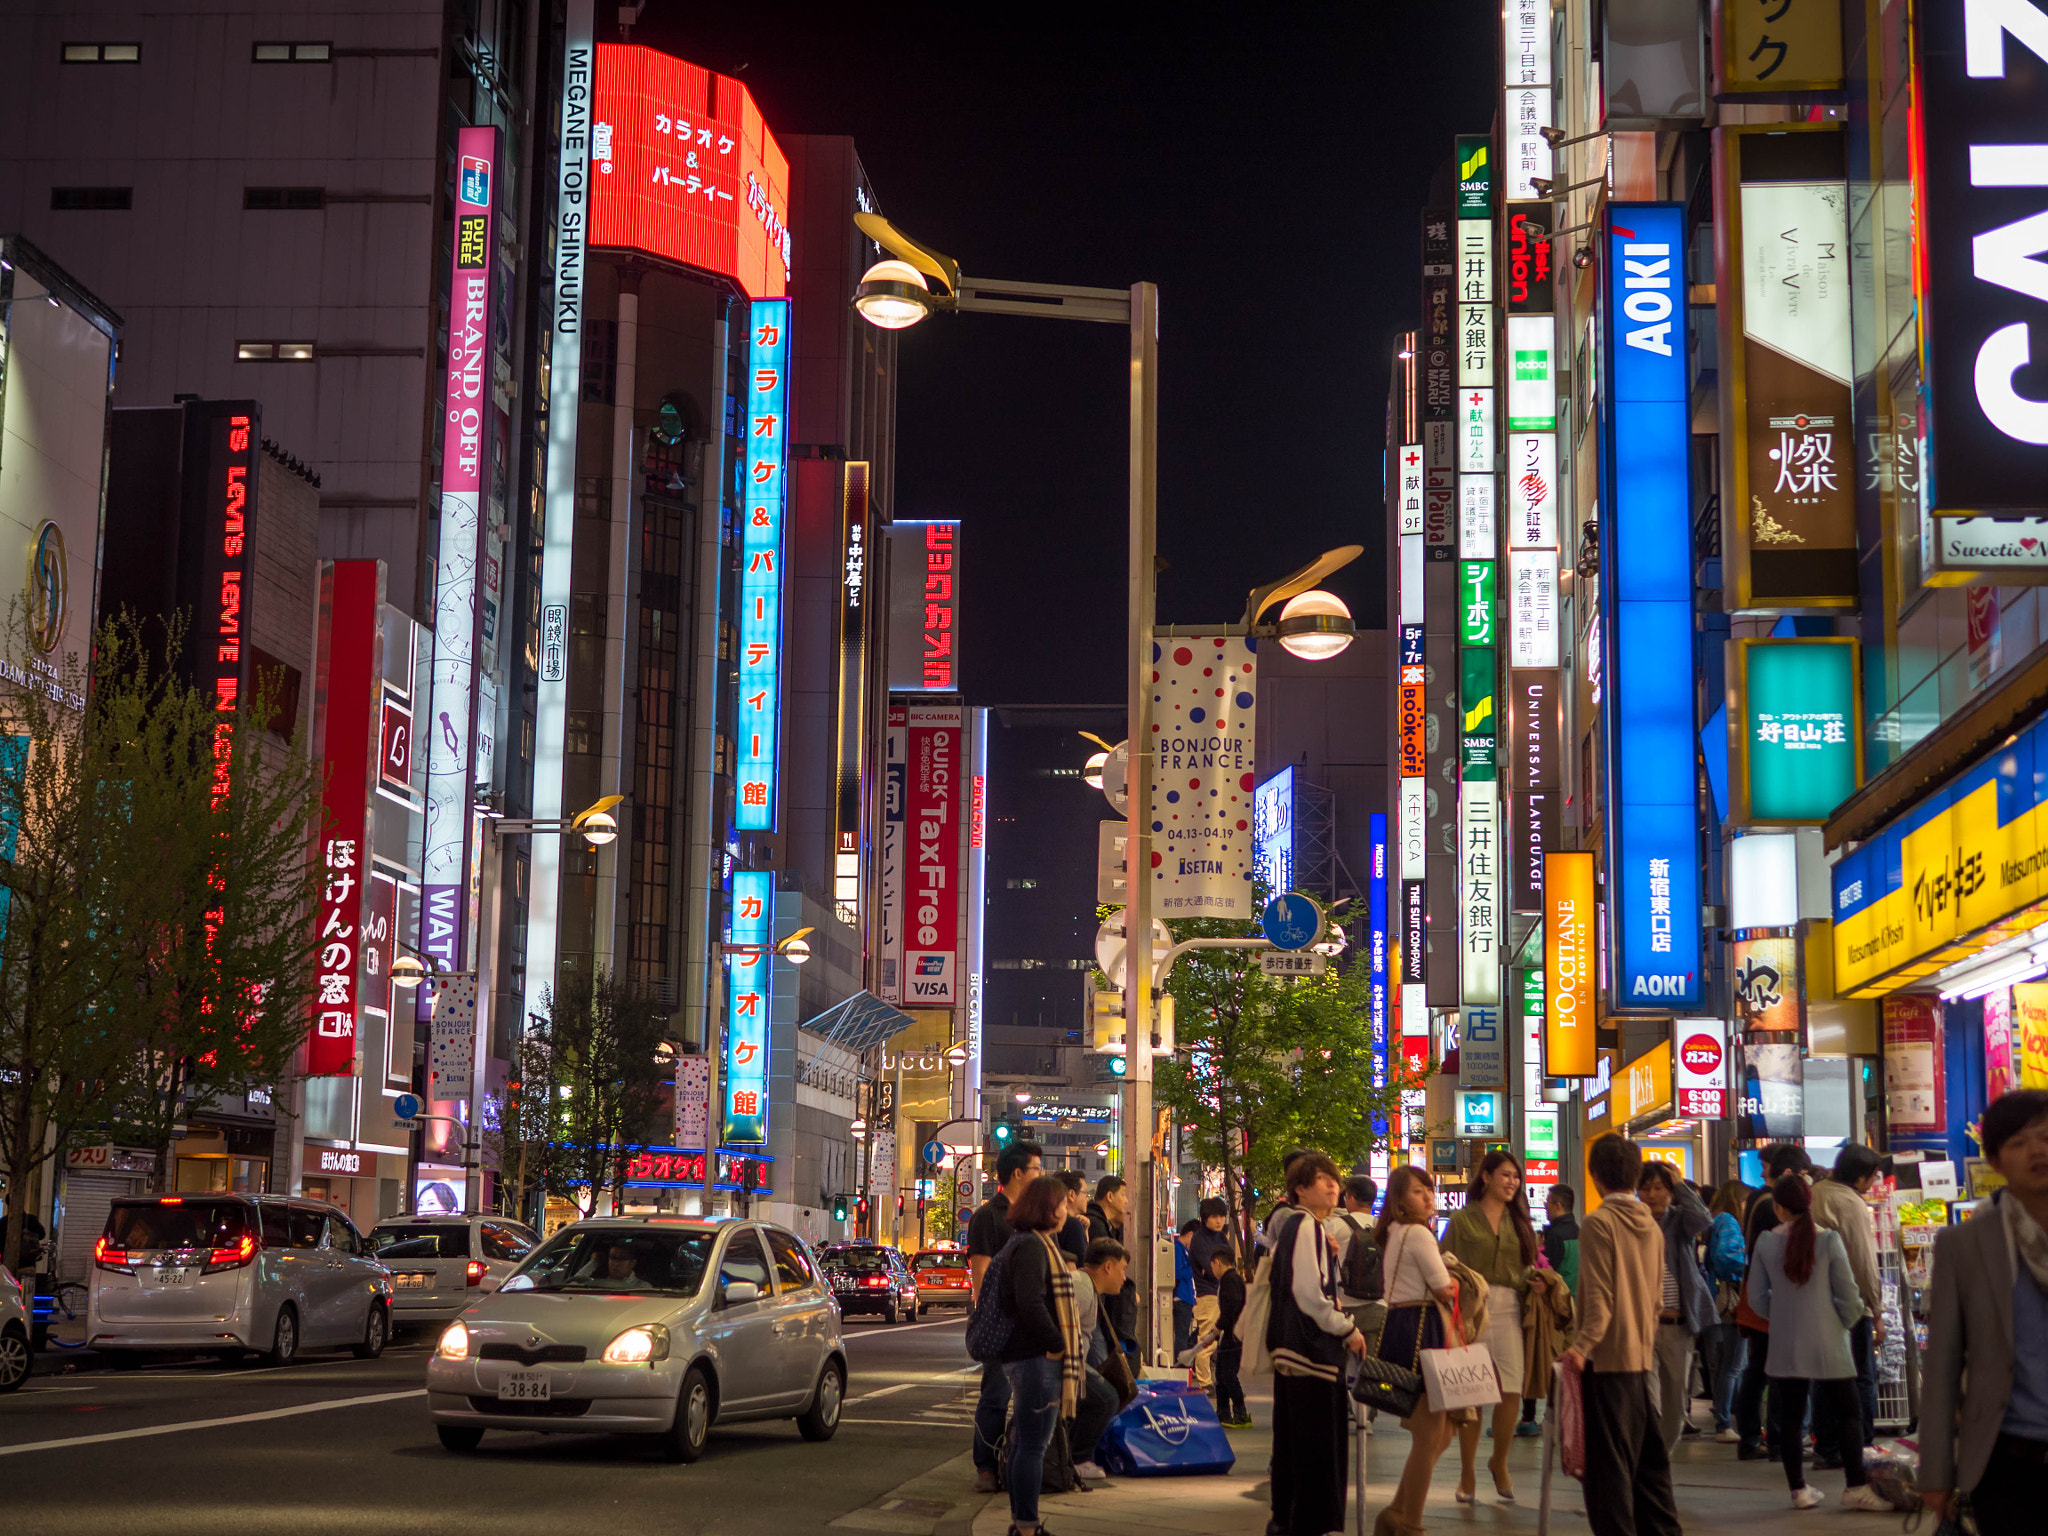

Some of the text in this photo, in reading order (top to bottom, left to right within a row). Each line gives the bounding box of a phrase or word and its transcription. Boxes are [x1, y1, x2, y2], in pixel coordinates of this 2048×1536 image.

[655, 113, 735, 155] カラオケ
[686, 151, 699, 170] &
[1521, 142, 1537, 171] 駅前
[556, 48, 588, 334] MEGANE TOP SHINJUKU
[652, 165, 733, 202] パーティー
[1459, 181, 1489, 191] SMBC
[460, 220, 473, 264] FREE
[472, 218, 485, 265] DUTY
[1817, 242, 1836, 300] Maison
[1464, 236, 1487, 371] 三井住友銀行
[1624, 243, 1673, 357] AOKI
[449, 329, 464, 423] TOKYO
[459, 276, 486, 477] BRAND OFF
[1427, 369, 1439, 405] MARU
[1438, 368, 1450, 405] NIJYU
[1432, 407, 1447, 416] 7F
[1469, 409, 1484, 459] 献血ルーム
[1768, 431, 1839, 494] 燦
[1405, 476, 1420, 510] 献血
[1428, 467, 1452, 543] La Pausa
[1525, 439, 1541, 542] ワンアジア証券
[1404, 517, 1421, 528] 9F
[1478, 486, 1489, 534] 新宿三丁目
[1434, 550, 1448, 560] 6F
[1948, 540, 2023, 557] Sweetie
[1518, 568, 1533, 654] 貸会議室 駅前
[1535, 568, 1550, 631] 新宿三丁目
[546, 608, 562, 679] 眼鏡市場
[1405, 628, 1422, 639] 5F
[1402, 667, 1425, 684] 本
[1405, 652, 1422, 663] 7F
[925, 713, 960, 721] CAMERA
[1756, 721, 1846, 743] 好日山荘
[1160, 736, 1243, 753] BONJOUR
[1463, 738, 1495, 748] SMBC
[932, 731, 950, 799] QUICK
[1160, 754, 1243, 769] FRANCE
[1527, 685, 1544, 890] UNIVERSAL LANGUAGE
[1168, 827, 1234, 839] 04.13-04.19
[1408, 794, 1421, 861] KEYUCA
[917, 801, 949, 946] TaxFree
[1178, 857, 1223, 875] ISETAN
[1467, 801, 1493, 953] 三井住友銀行
[1162, 896, 1235, 909] 新宿大通商店街
[1649, 858, 1672, 953] 新宿東口店
[1409, 884, 1422, 979] THE SUIT COMPANY
[1265, 957, 1313, 971] 歩行者優先
[1555, 899, 1576, 1028] L'OCCITANE
[1577, 922, 1586, 1004] EN PROVENCE
[911, 982, 949, 996] VISA
[1632, 975, 1686, 996] AOKI
[435, 1020, 471, 1028] BONJOUR
[968, 972, 980, 1061] BIC CAMERA
[1685, 1050, 1720, 1064] ガスト
[1688, 1090, 1721, 1102] 6:00
[1709, 1078, 1723, 1086] 4F
[158, 1274, 183, 1285] 45-22
[510, 1382, 548, 1398] 38-84
[1438, 1363, 1493, 1386] KIKKA
